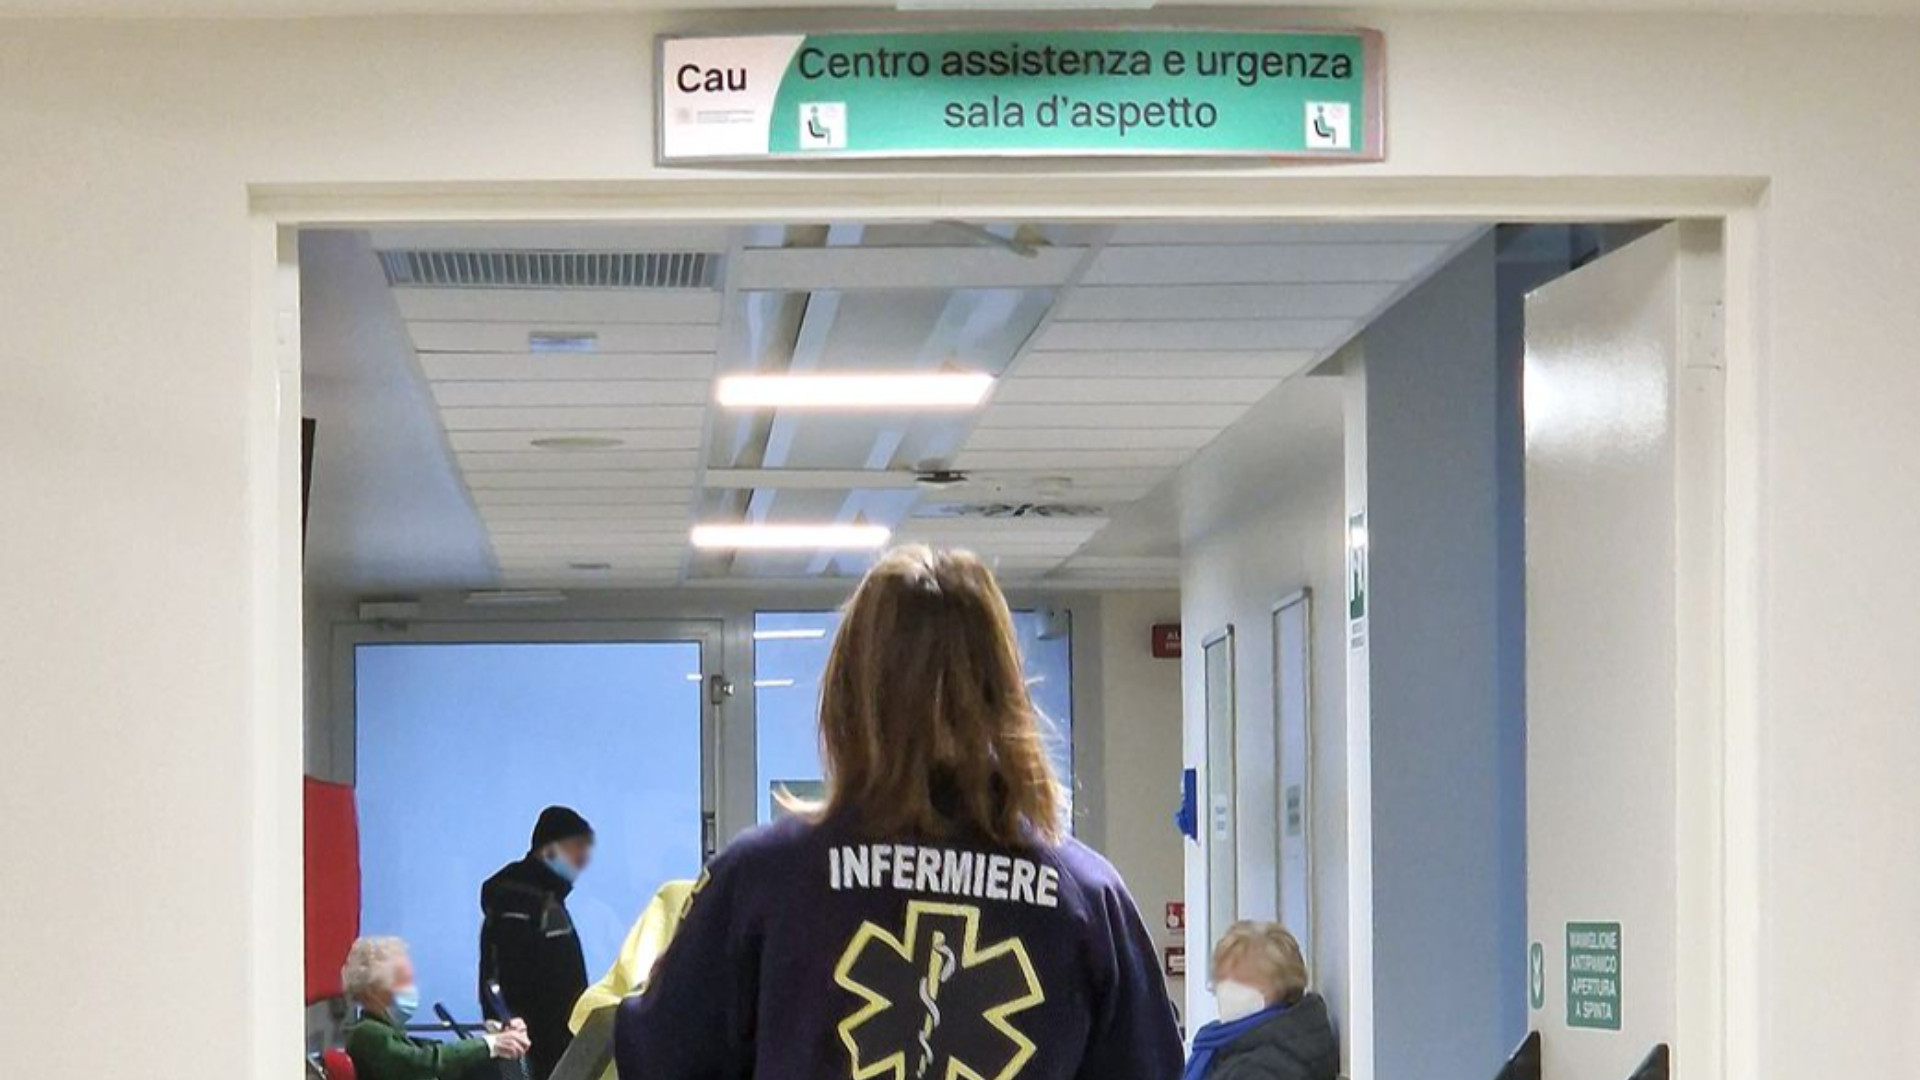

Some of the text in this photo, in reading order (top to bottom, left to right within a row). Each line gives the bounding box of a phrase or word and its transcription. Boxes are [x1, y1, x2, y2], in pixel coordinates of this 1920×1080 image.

[675, 62, 748, 95] Cau
[797, 43, 1354, 88] Centro assistenza e urgenza
[943, 94, 1218, 138] sala d'aspetto
[829, 844, 1059, 908] INFERMIERE
[1571, 977, 1616, 997] APERTURA
[1575, 1001, 1613, 1020] A SPINTA
